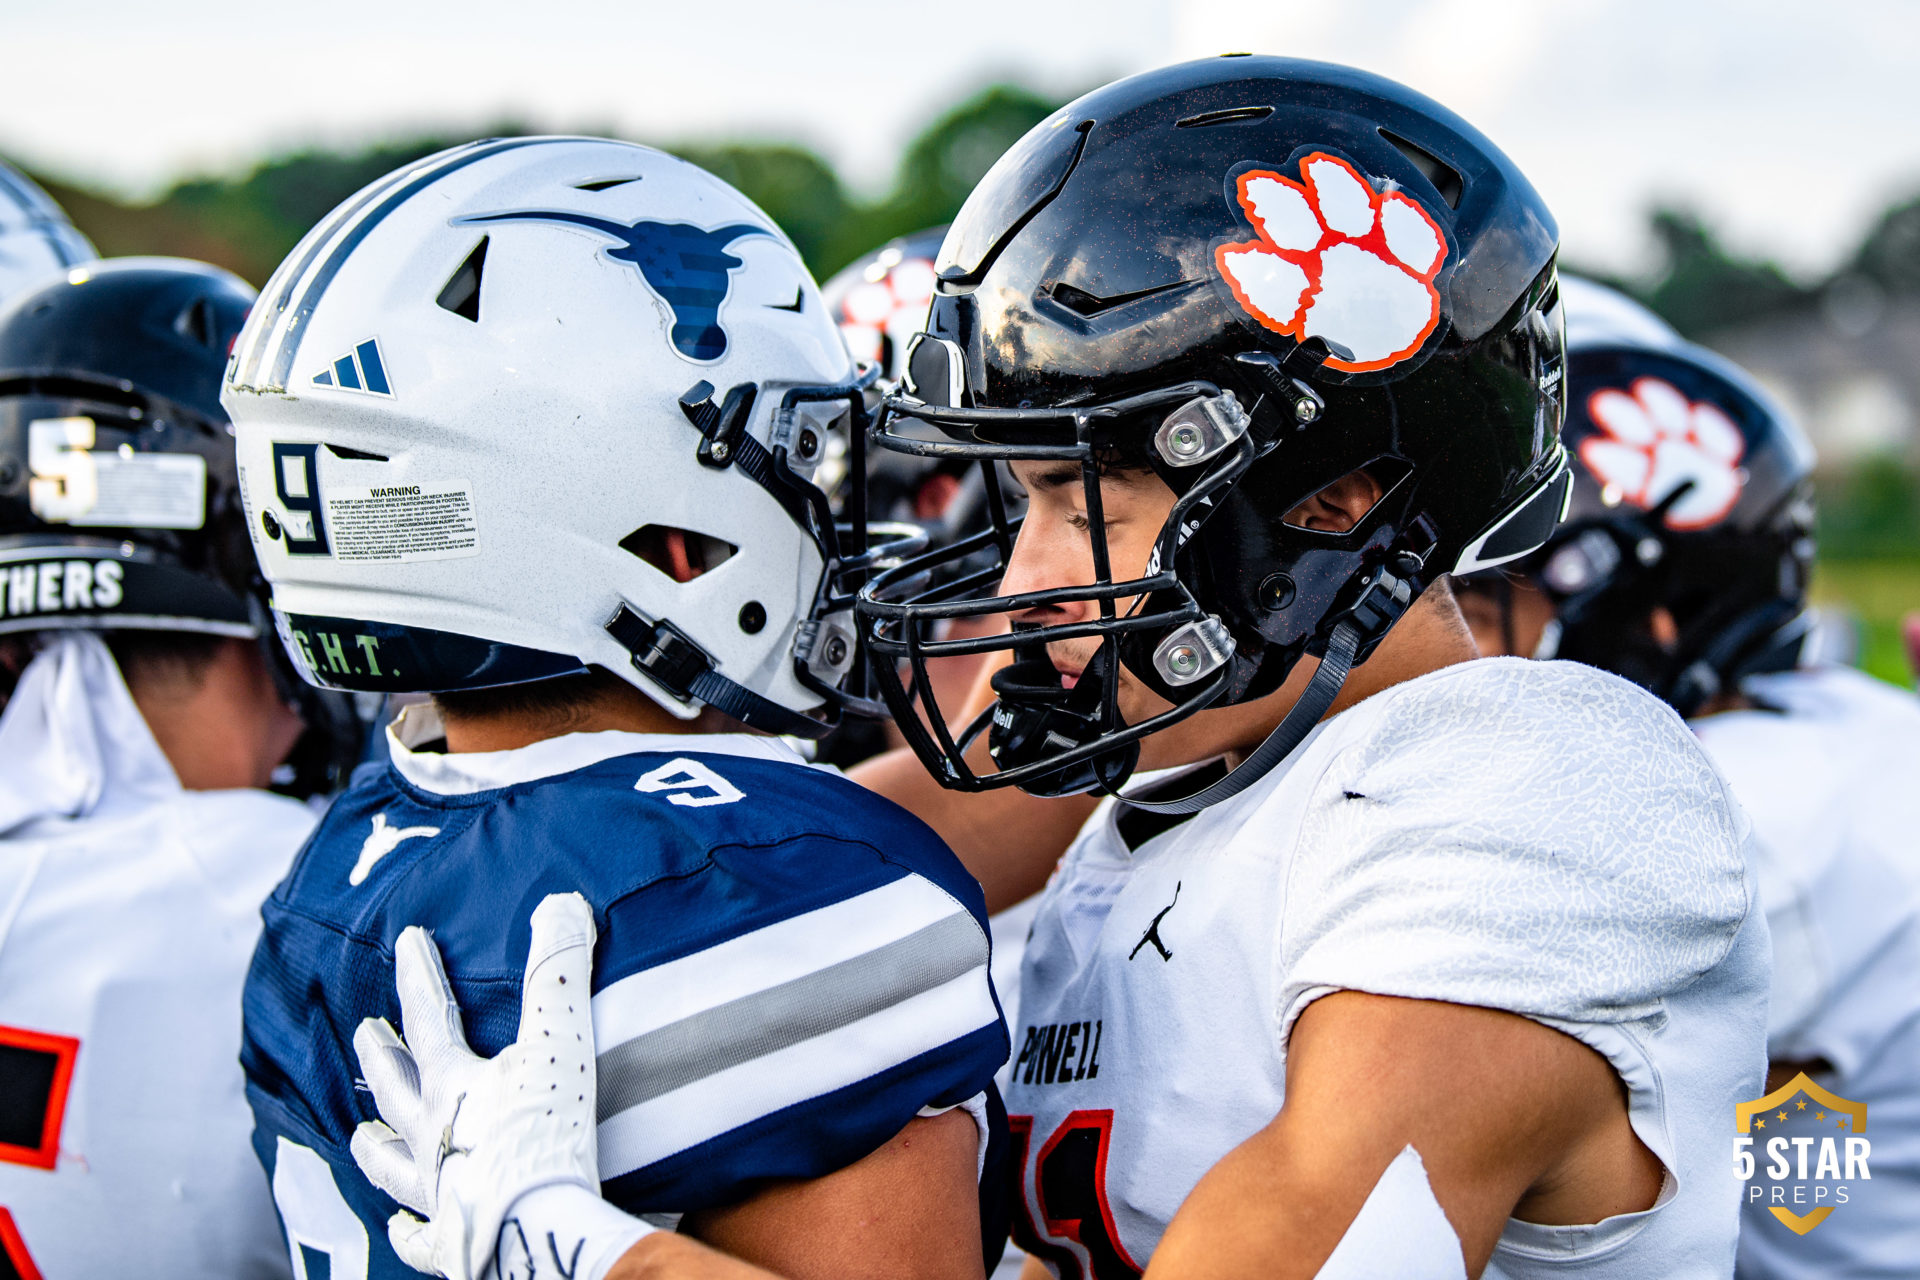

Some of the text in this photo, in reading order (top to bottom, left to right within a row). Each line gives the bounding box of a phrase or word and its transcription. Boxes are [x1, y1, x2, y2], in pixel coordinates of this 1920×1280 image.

[28, 416, 96, 524] 5
[272, 441, 333, 558] 9
[370, 486, 420, 497] WARNING
[634, 757, 747, 807] 9
[1011, 1020, 1103, 1085] POWELL
